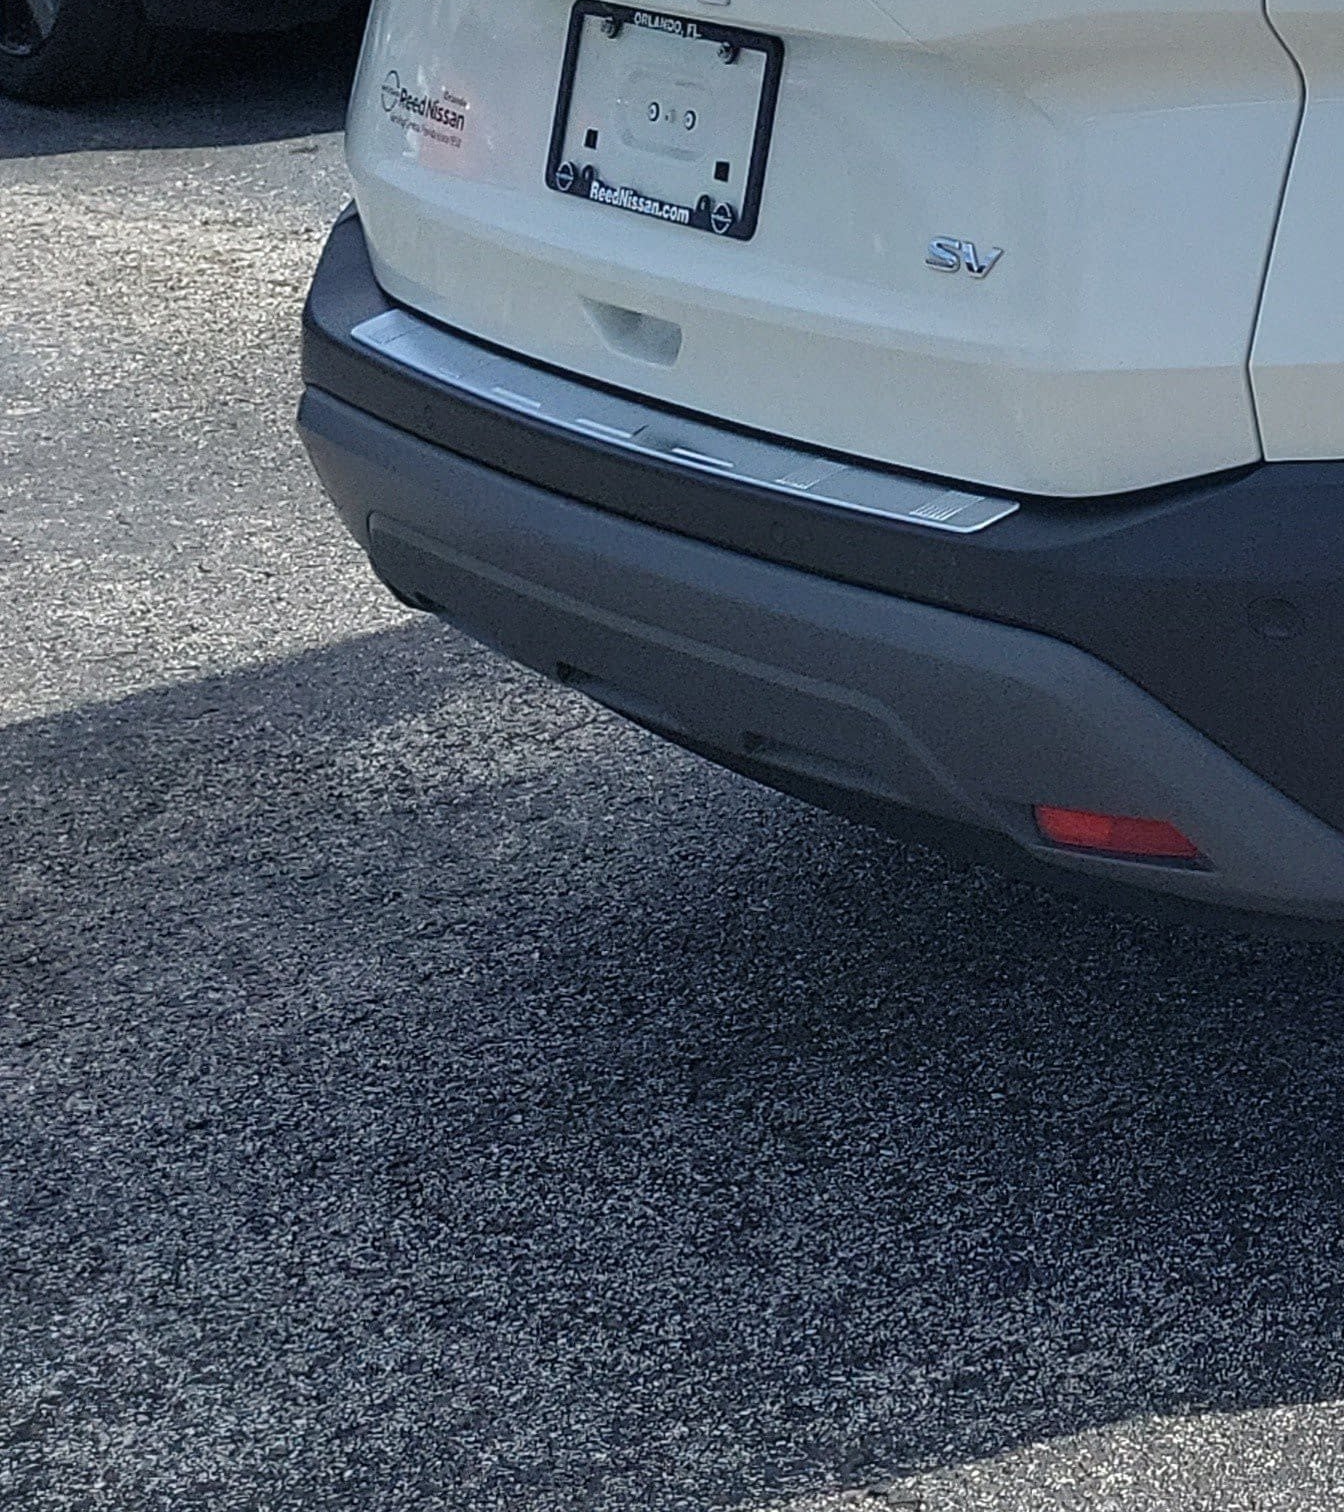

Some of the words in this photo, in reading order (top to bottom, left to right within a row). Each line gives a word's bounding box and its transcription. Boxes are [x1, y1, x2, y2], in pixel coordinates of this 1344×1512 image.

[686, 22, 702, 38] FL
[589, 180, 691, 225] ReedNissan.com
[924, 235, 1005, 280] SV
